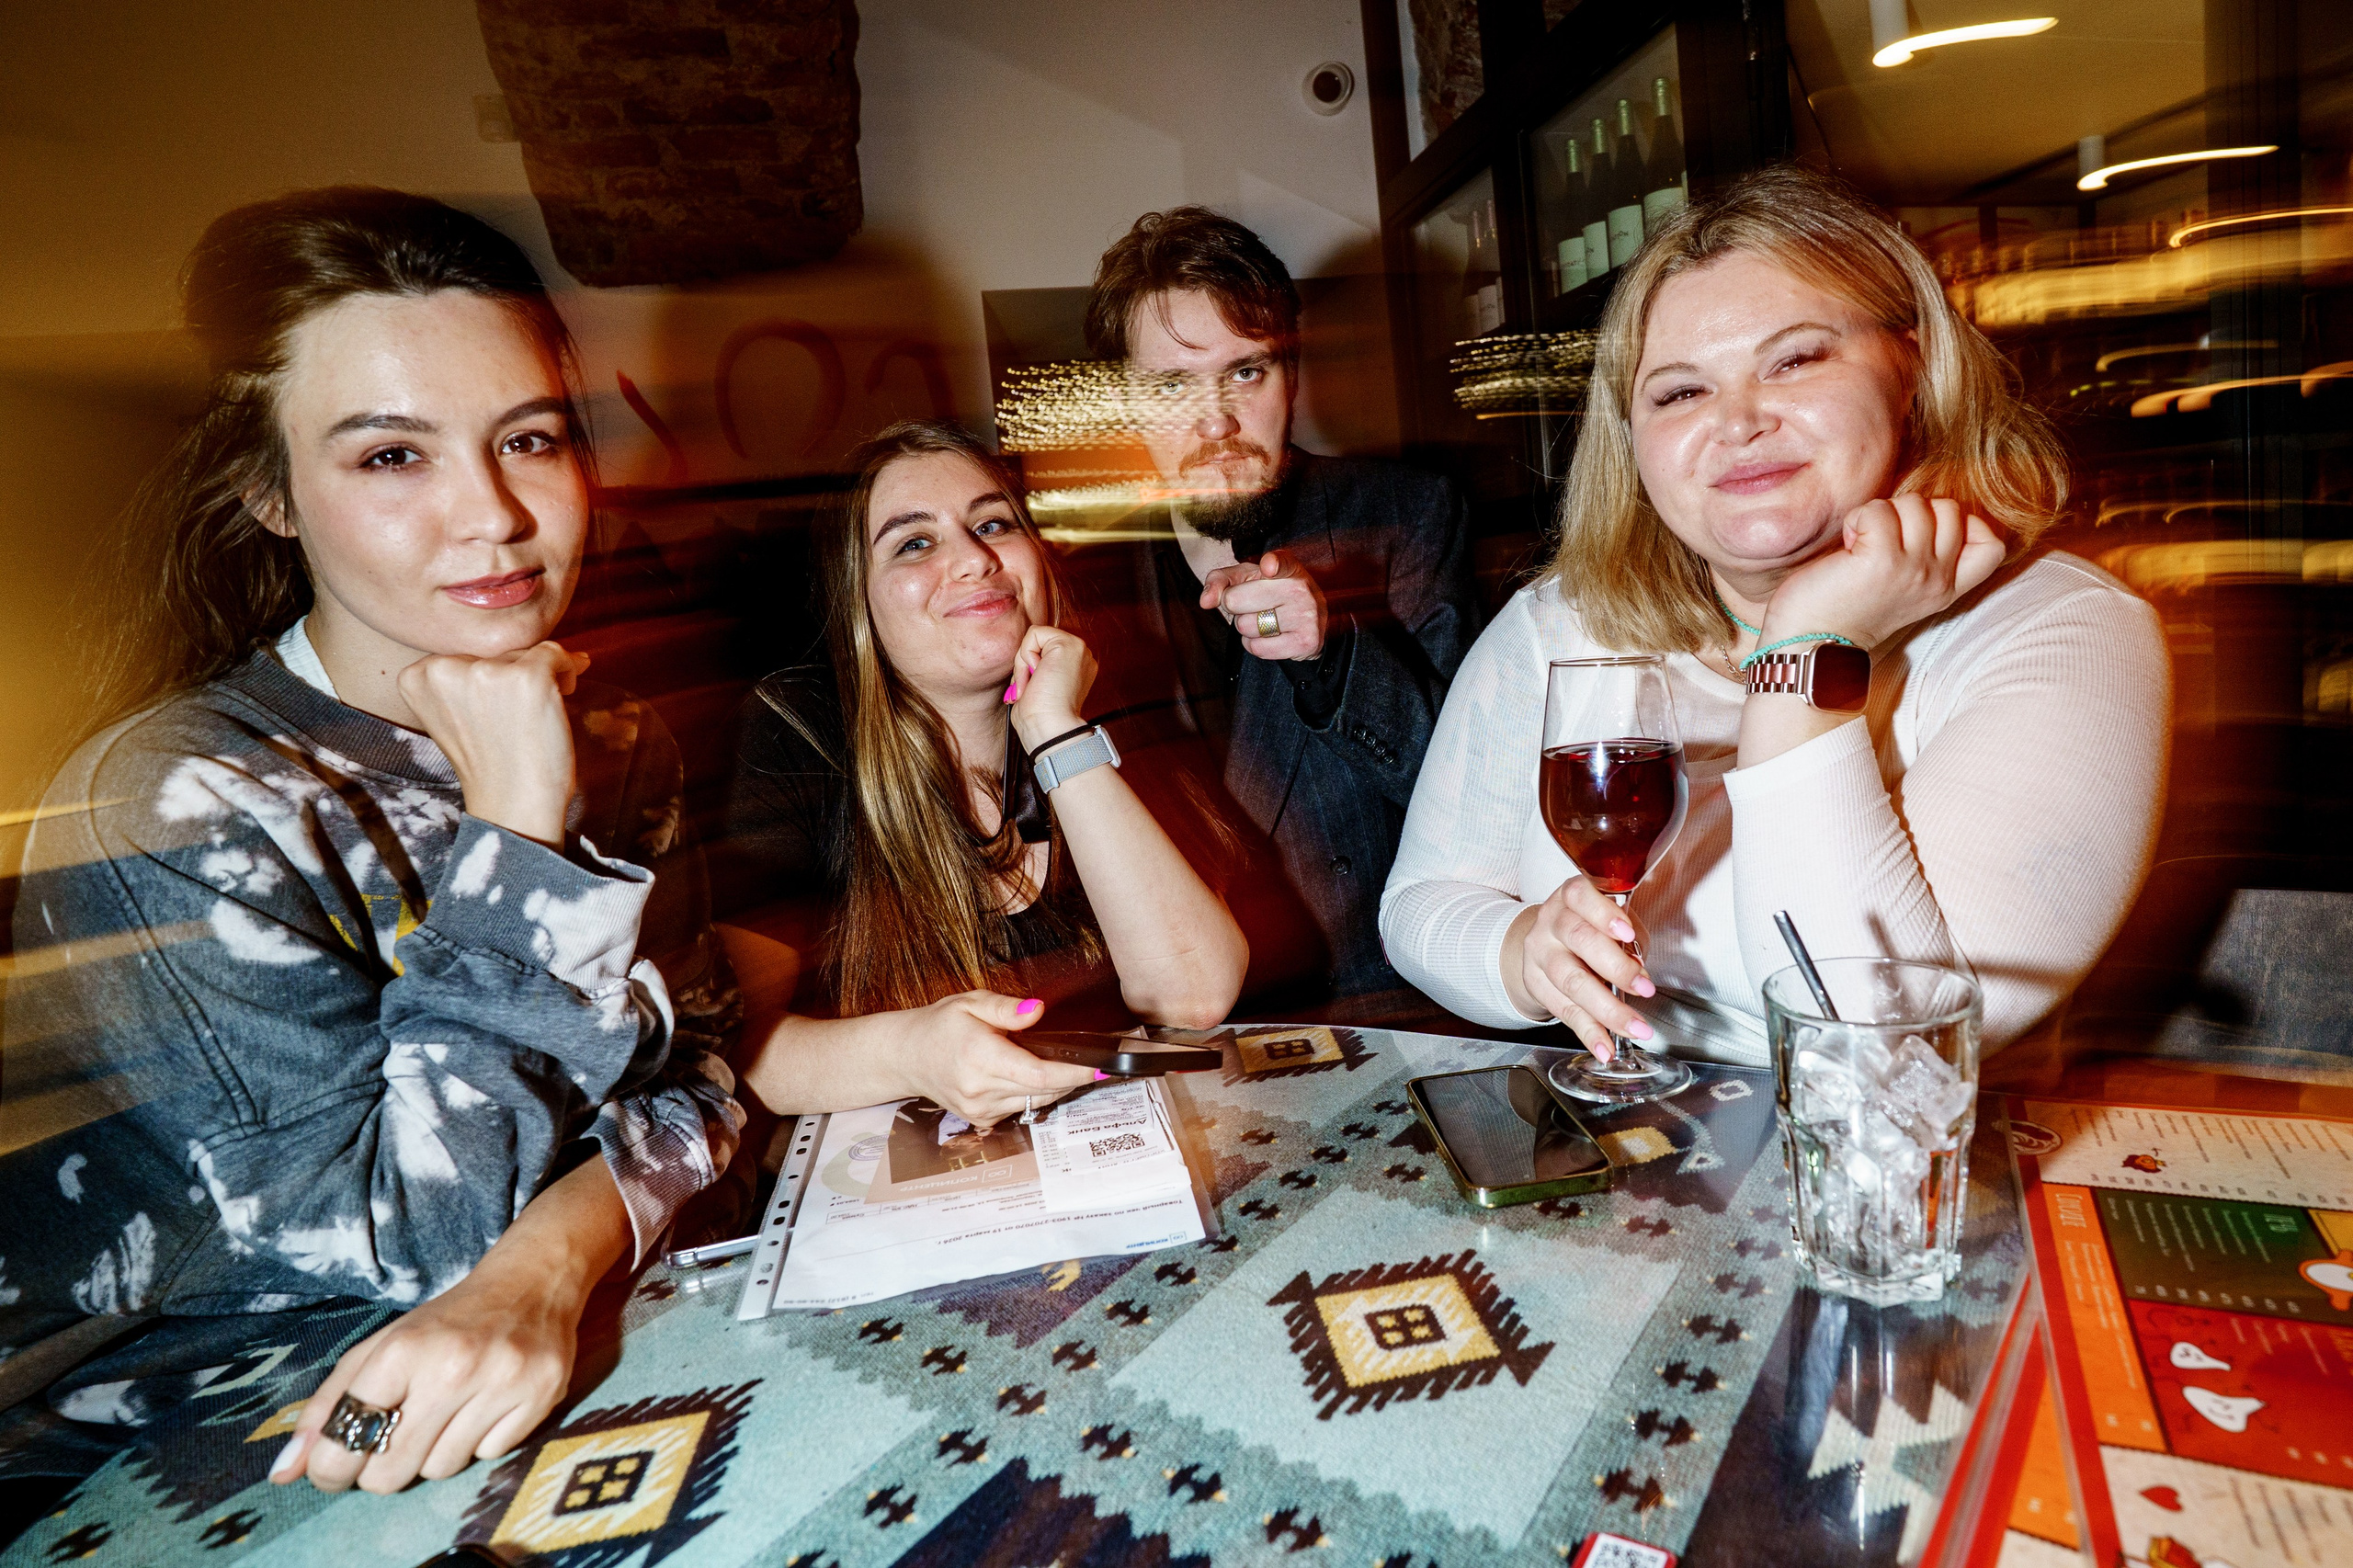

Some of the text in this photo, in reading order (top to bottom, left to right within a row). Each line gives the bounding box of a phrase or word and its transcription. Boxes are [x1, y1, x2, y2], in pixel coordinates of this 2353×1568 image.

[1066, 1117, 1147, 1136] Альфа Банк
[899, 1175, 978, 1193] КОПИЦЕНТР
